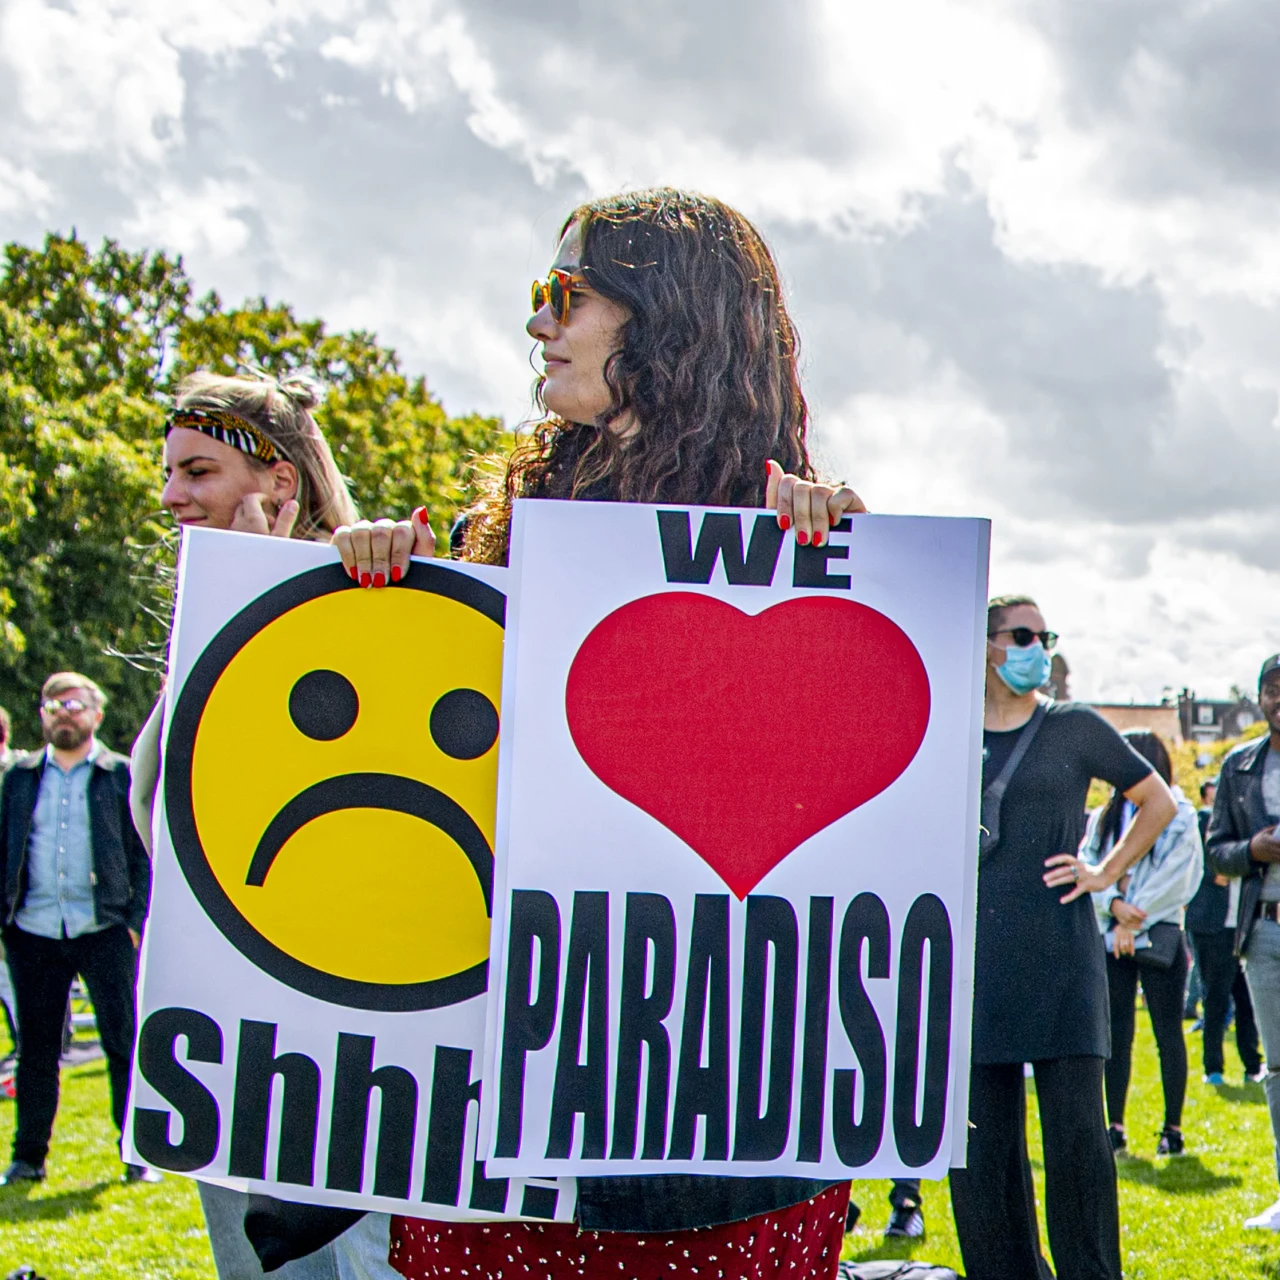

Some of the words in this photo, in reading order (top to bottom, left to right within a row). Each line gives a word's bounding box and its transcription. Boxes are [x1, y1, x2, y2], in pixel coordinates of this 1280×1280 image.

[656, 510, 853, 590] WE
[133, 1007, 559, 1220] Shhh
[493, 888, 954, 1168] PARADISO
